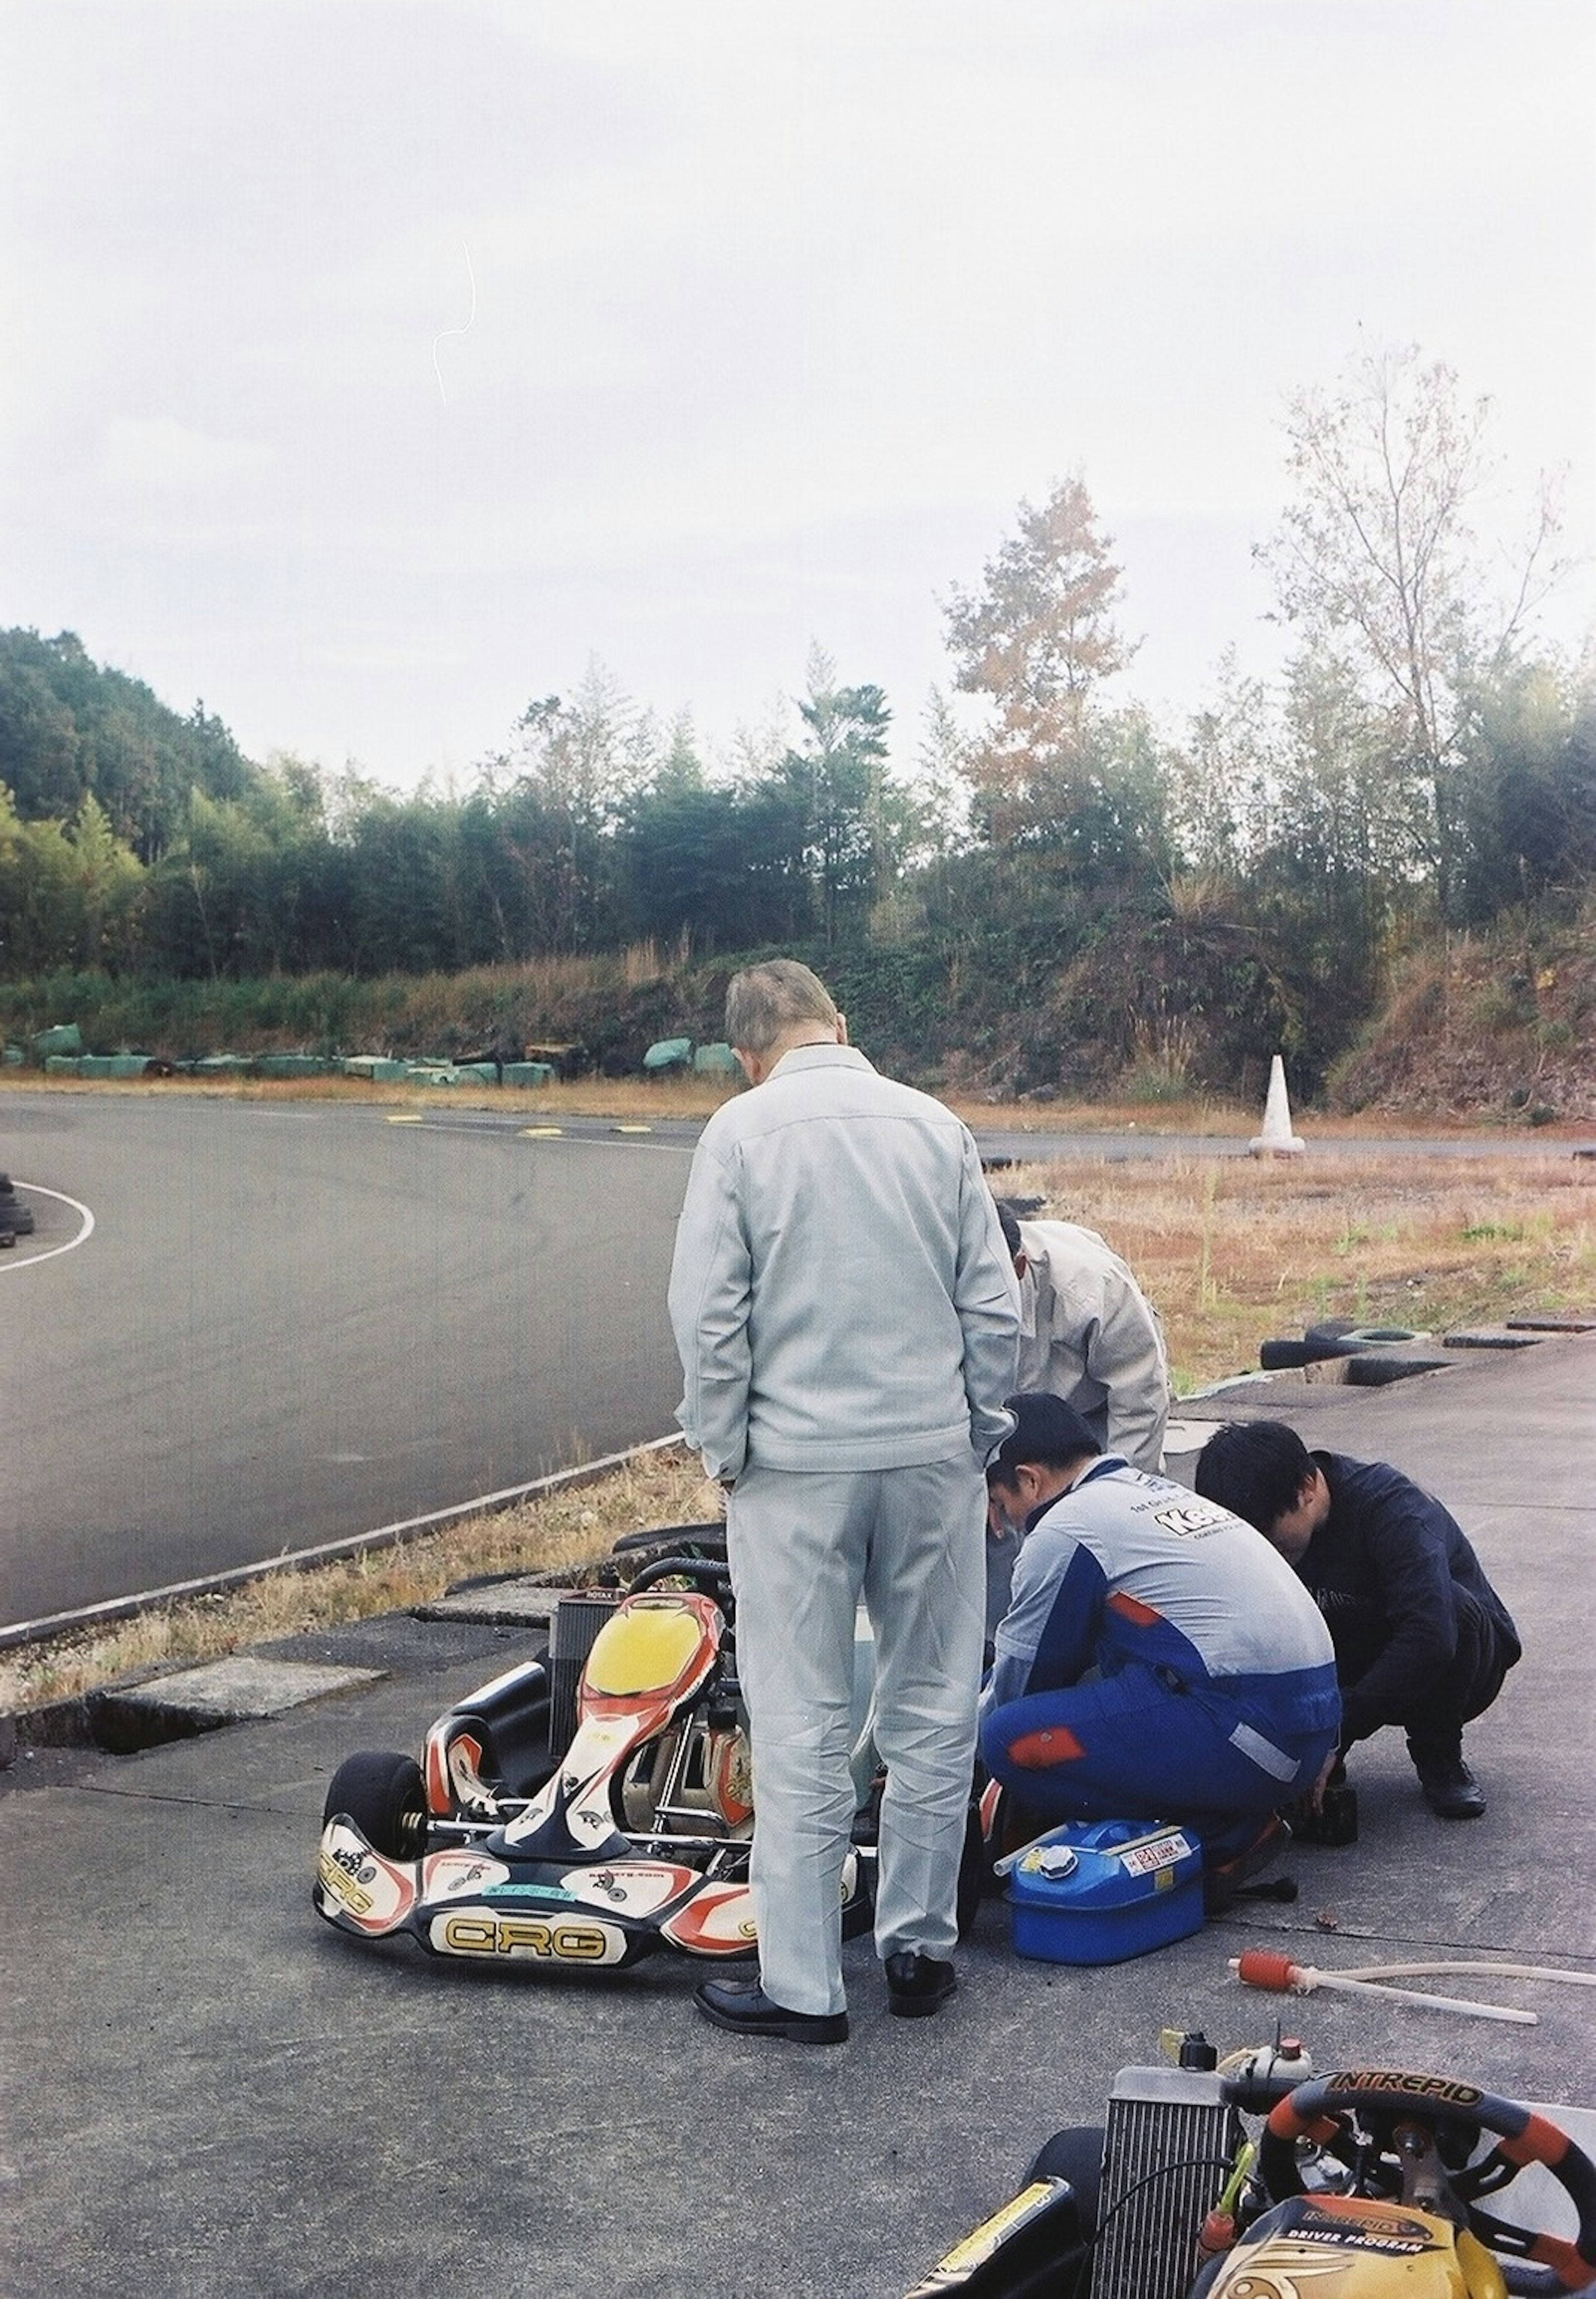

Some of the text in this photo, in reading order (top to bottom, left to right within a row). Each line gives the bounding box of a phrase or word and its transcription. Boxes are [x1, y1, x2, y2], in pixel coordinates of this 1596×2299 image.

[318, 1850, 375, 1915] CRG
[446, 1918, 606, 1959] CRG
[1327, 2071, 1484, 2107] INTREPID
[1288, 2229, 1424, 2252] DRIVER PROGRAM
